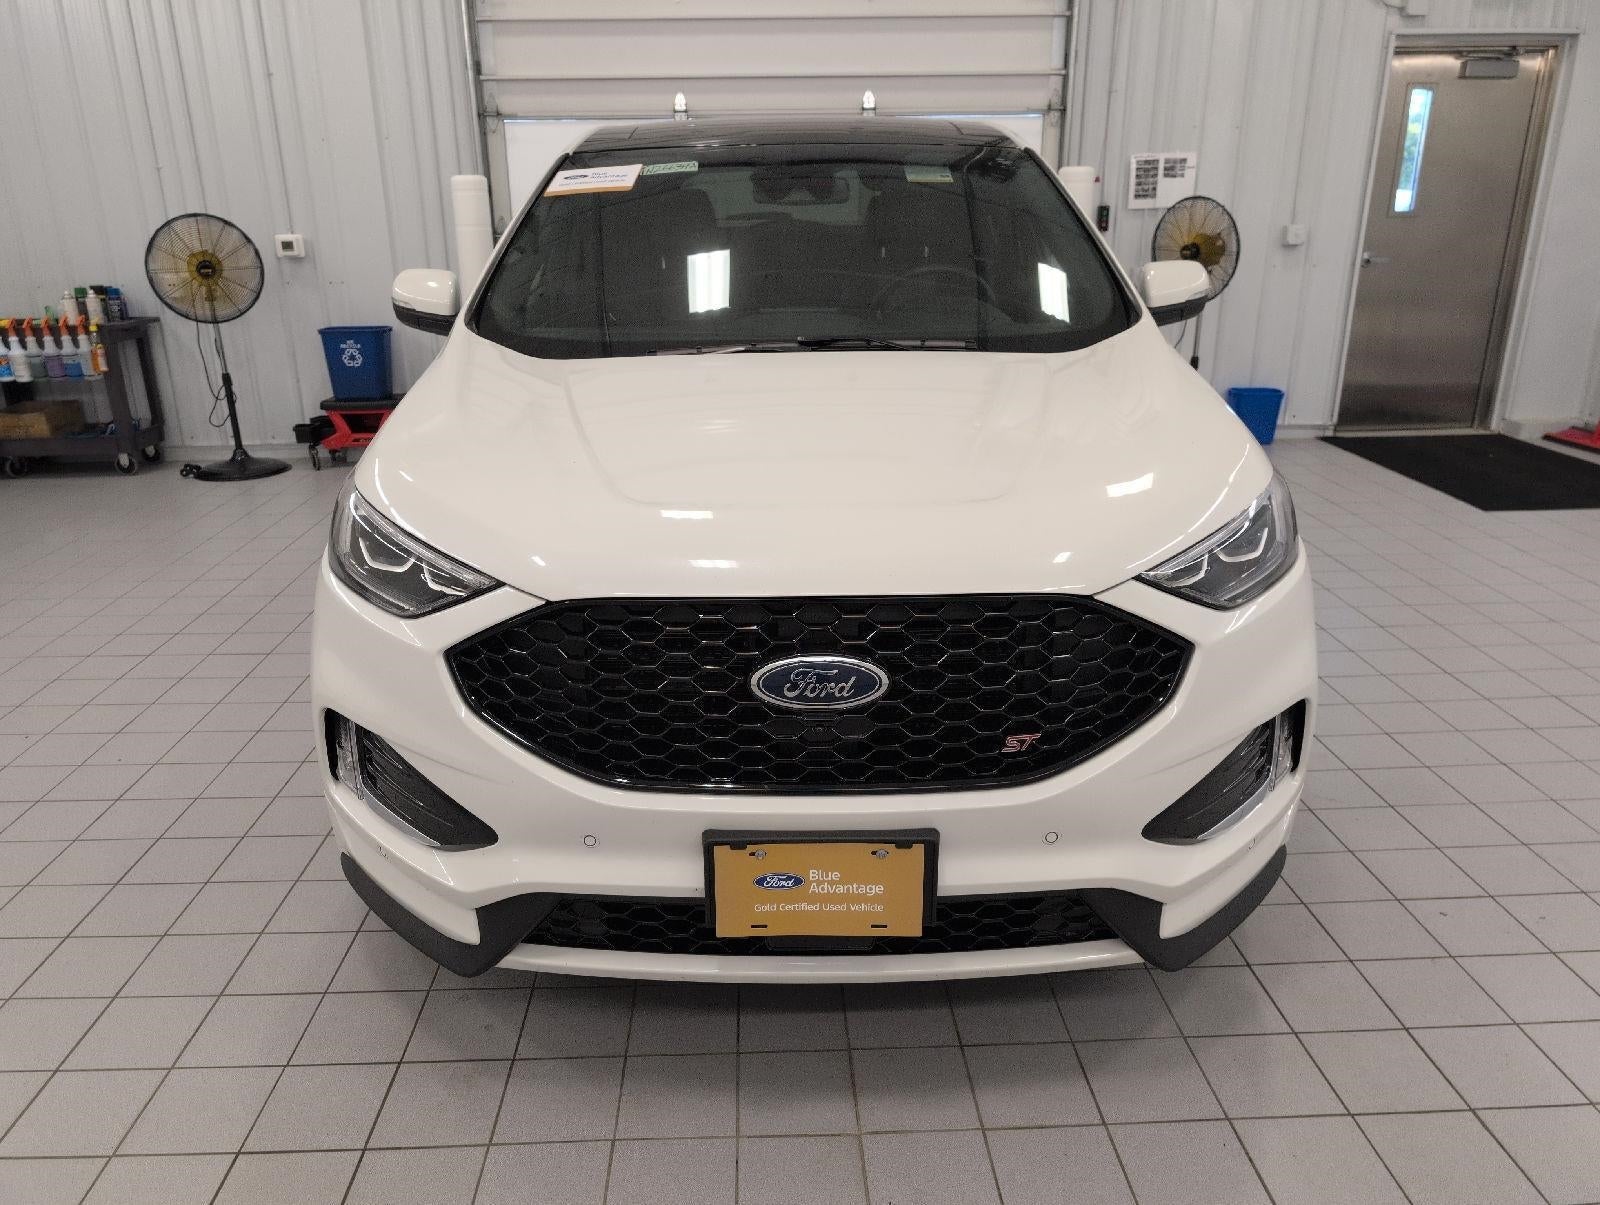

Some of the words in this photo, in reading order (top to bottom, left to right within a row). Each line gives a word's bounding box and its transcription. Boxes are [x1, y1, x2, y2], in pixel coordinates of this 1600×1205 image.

[783, 668, 857, 698] Ford
[1001, 733, 1041, 752] ST
[763, 874, 794, 887] Ford
[808, 869, 840, 881] Blue
[808, 882, 884, 896] Advantage
[754, 903, 777, 911] Gold
[779, 903, 820, 911] Certified
[822, 903, 847, 911] Used
[850, 903, 884, 911] Vehicle
